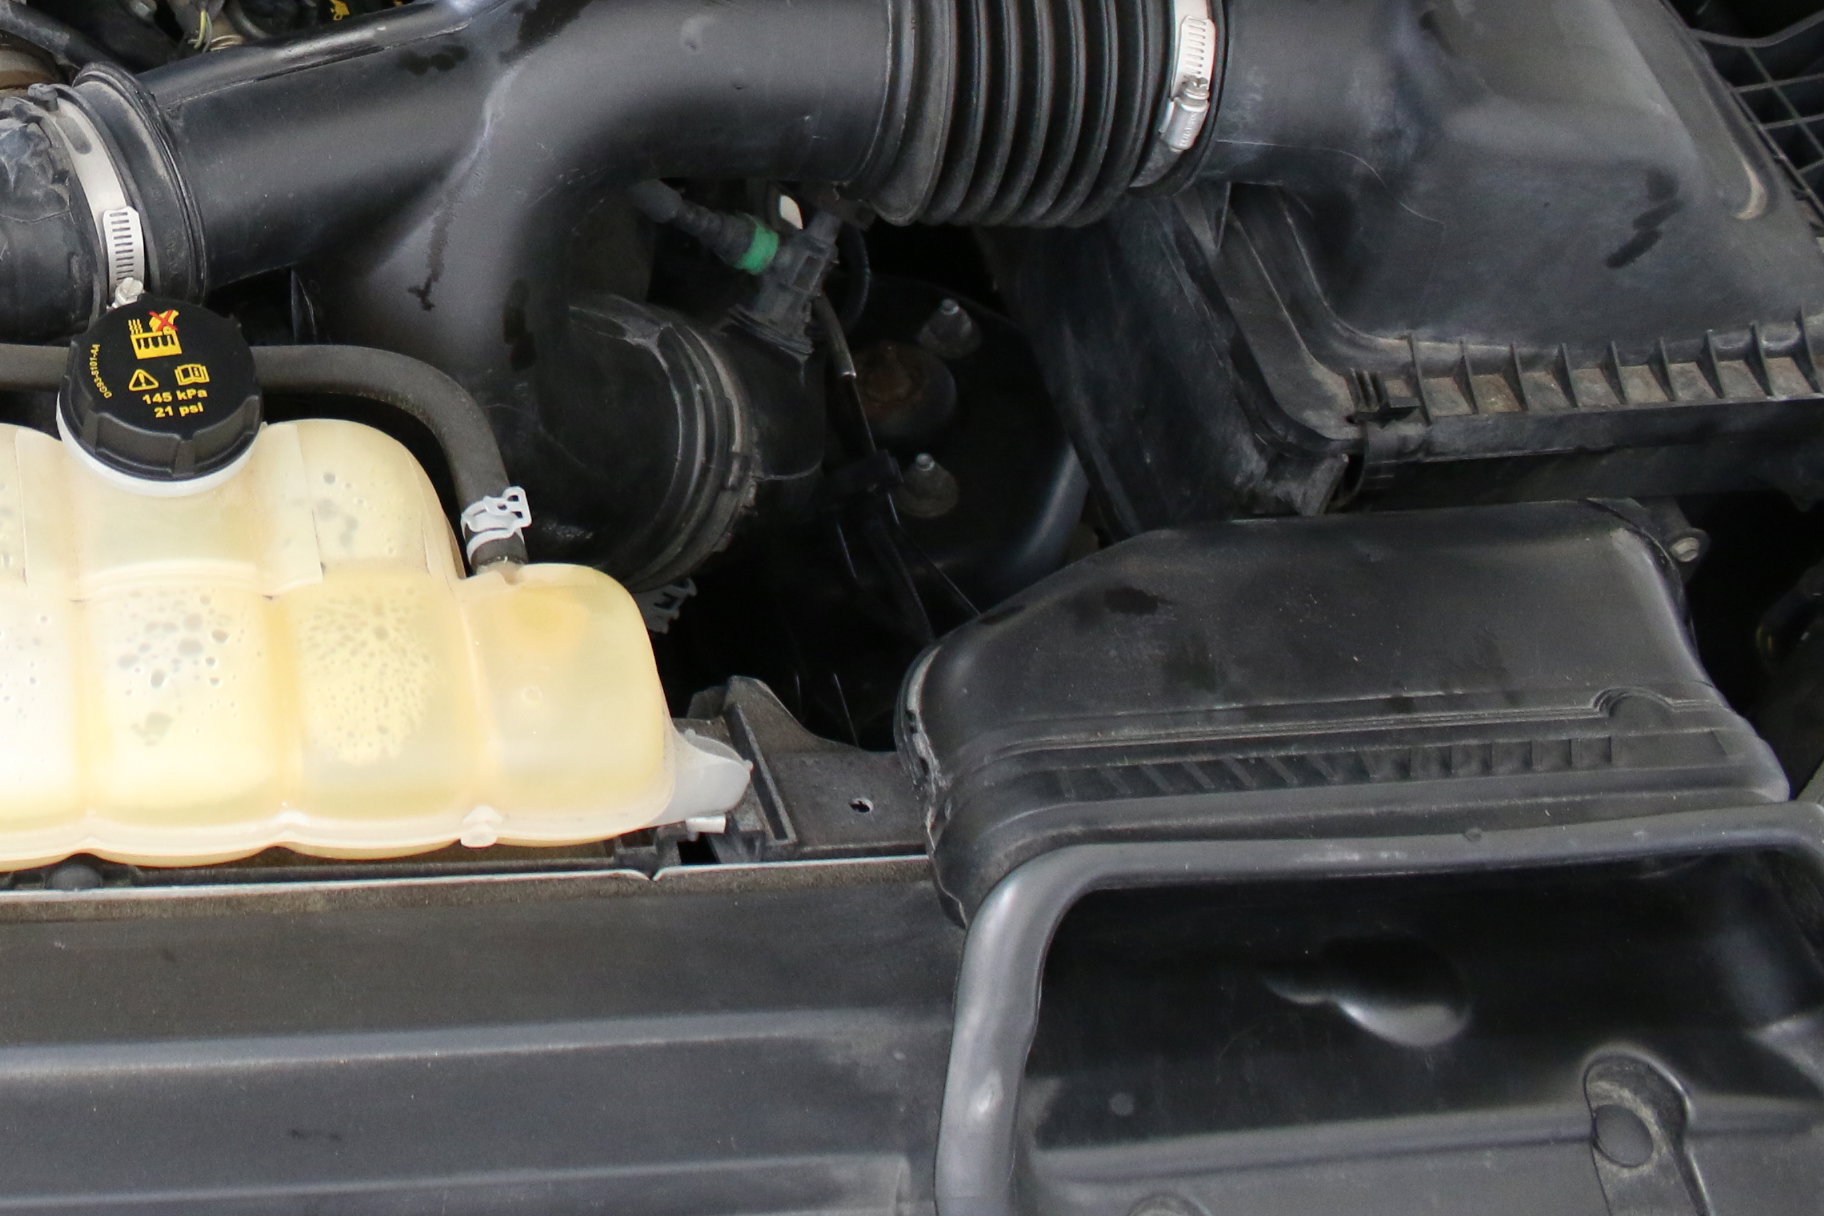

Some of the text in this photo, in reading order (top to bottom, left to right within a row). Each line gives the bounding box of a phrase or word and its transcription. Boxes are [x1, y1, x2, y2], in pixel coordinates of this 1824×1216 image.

[142, 388, 207, 405] 145 kPa
[154, 401, 204, 418] 21 psi
